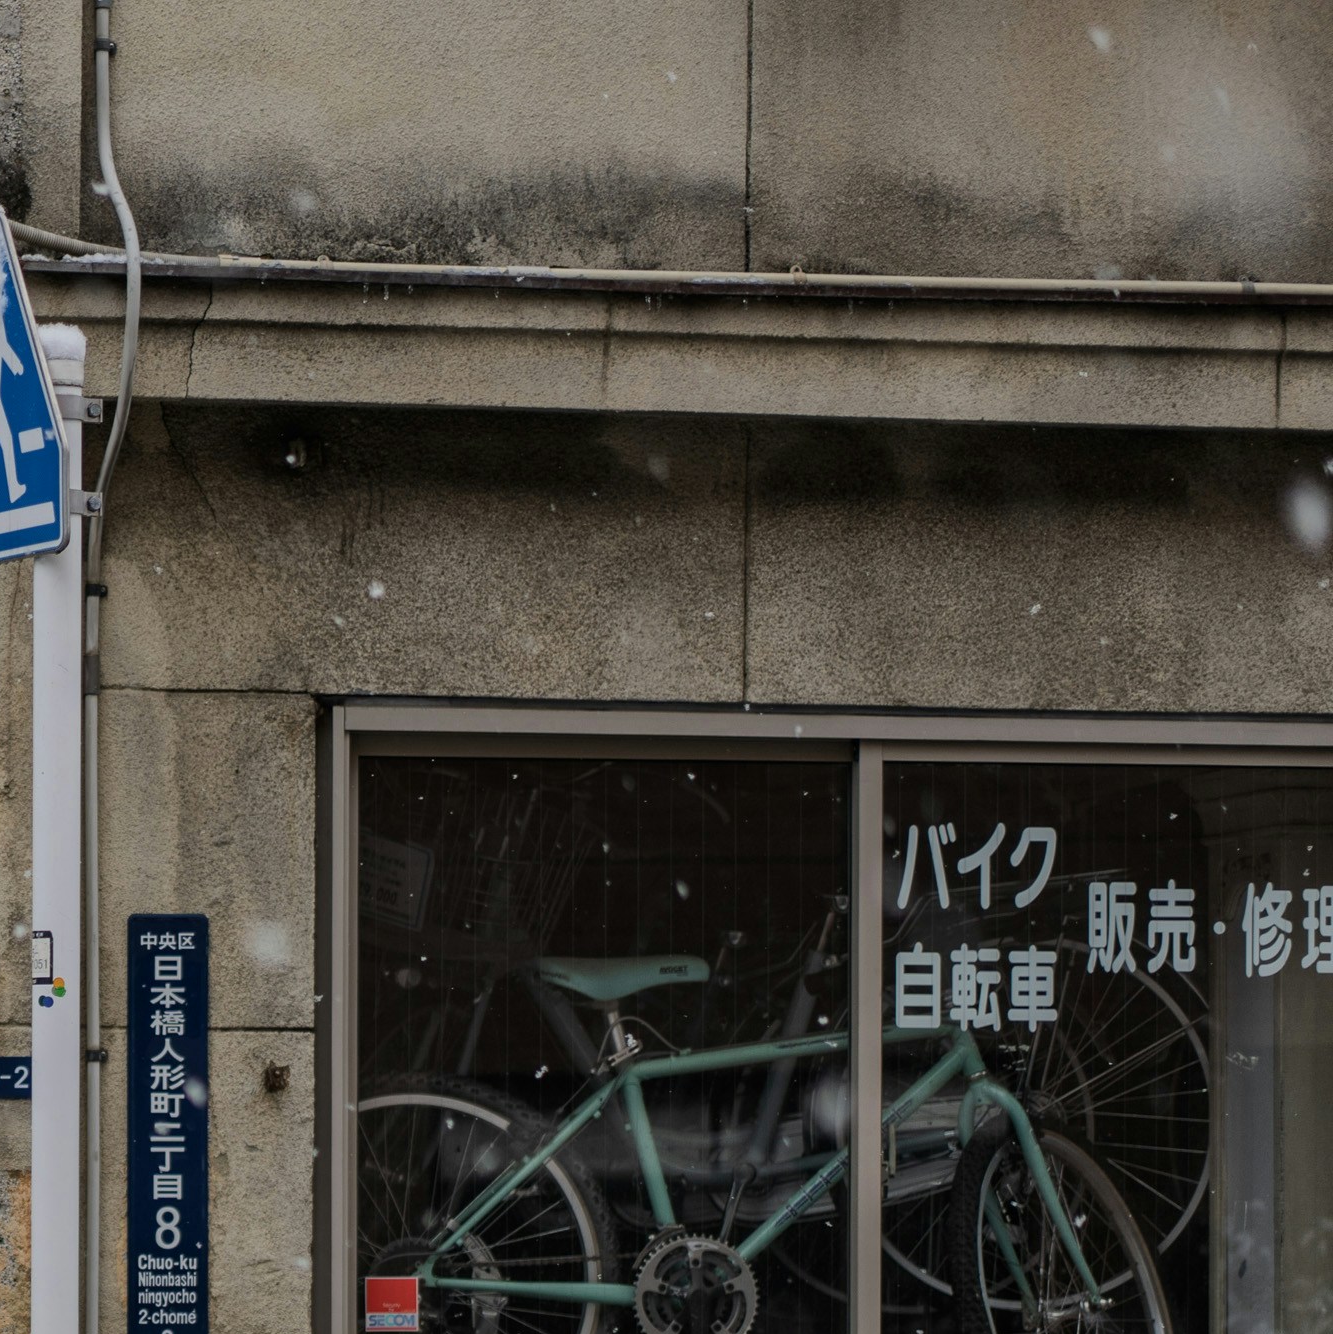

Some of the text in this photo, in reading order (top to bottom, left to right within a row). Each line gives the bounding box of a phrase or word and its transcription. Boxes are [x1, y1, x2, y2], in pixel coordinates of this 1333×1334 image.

[897, 823, 1057, 909] バイク
[140, 931, 196, 951] 中央区
[896, 942, 1058, 1032] 自転車
[149, 955, 186, 1250] 日本橋人形町二丁目 8
[137, 1254, 198, 1270] Chuo-ku
[138, 1272, 198, 1287] Nihonbashi
[138, 1289, 197, 1307] ningyocho
[368, 1314, 415, 1326] SECOM
